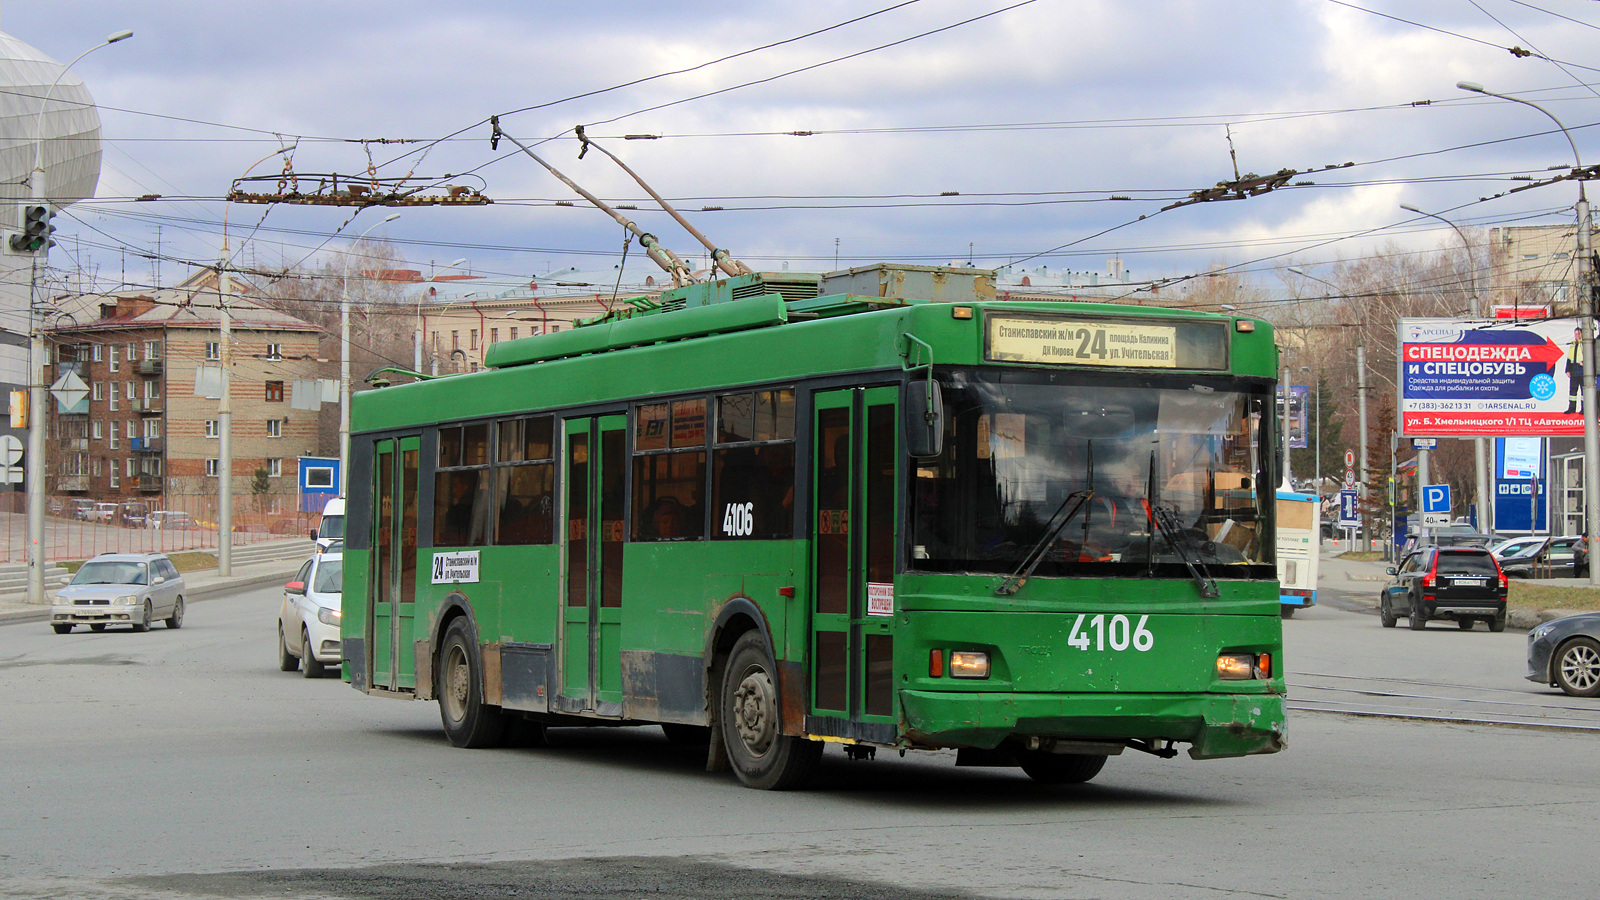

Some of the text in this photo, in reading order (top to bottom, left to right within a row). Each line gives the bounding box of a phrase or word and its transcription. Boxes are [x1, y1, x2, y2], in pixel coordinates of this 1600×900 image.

[999, 325, 1074, 341] Станиславский ж/м
[1109, 333, 1169, 345] площадь Калинина
[1075, 328, 1107, 360] 24
[1042, 346, 1074, 357] ДК Кирова
[1109, 347, 1169, 361] ул. Учительская
[1408, 346, 1532, 361] СПЕЦОДЕЖДА
[1408, 362, 1526, 376] и СПЕЦОБУВЬ
[1408, 377, 1438, 385] Средства
[1439, 377, 1491, 385] индивидуальной
[1418, 402, 1453, 410] (383)-362
[1407, 419, 1421, 427] ул.
[1423, 418, 1433, 426] Б.
[1434, 418, 1504, 427] Хмельницкого
[1505, 418, 1517, 426] 1/1
[1518, 418, 1532, 427] ТЦ
[723, 501, 754, 536] 4106
[434, 556, 444, 580] 24
[1067, 614, 1154, 652] 4106
